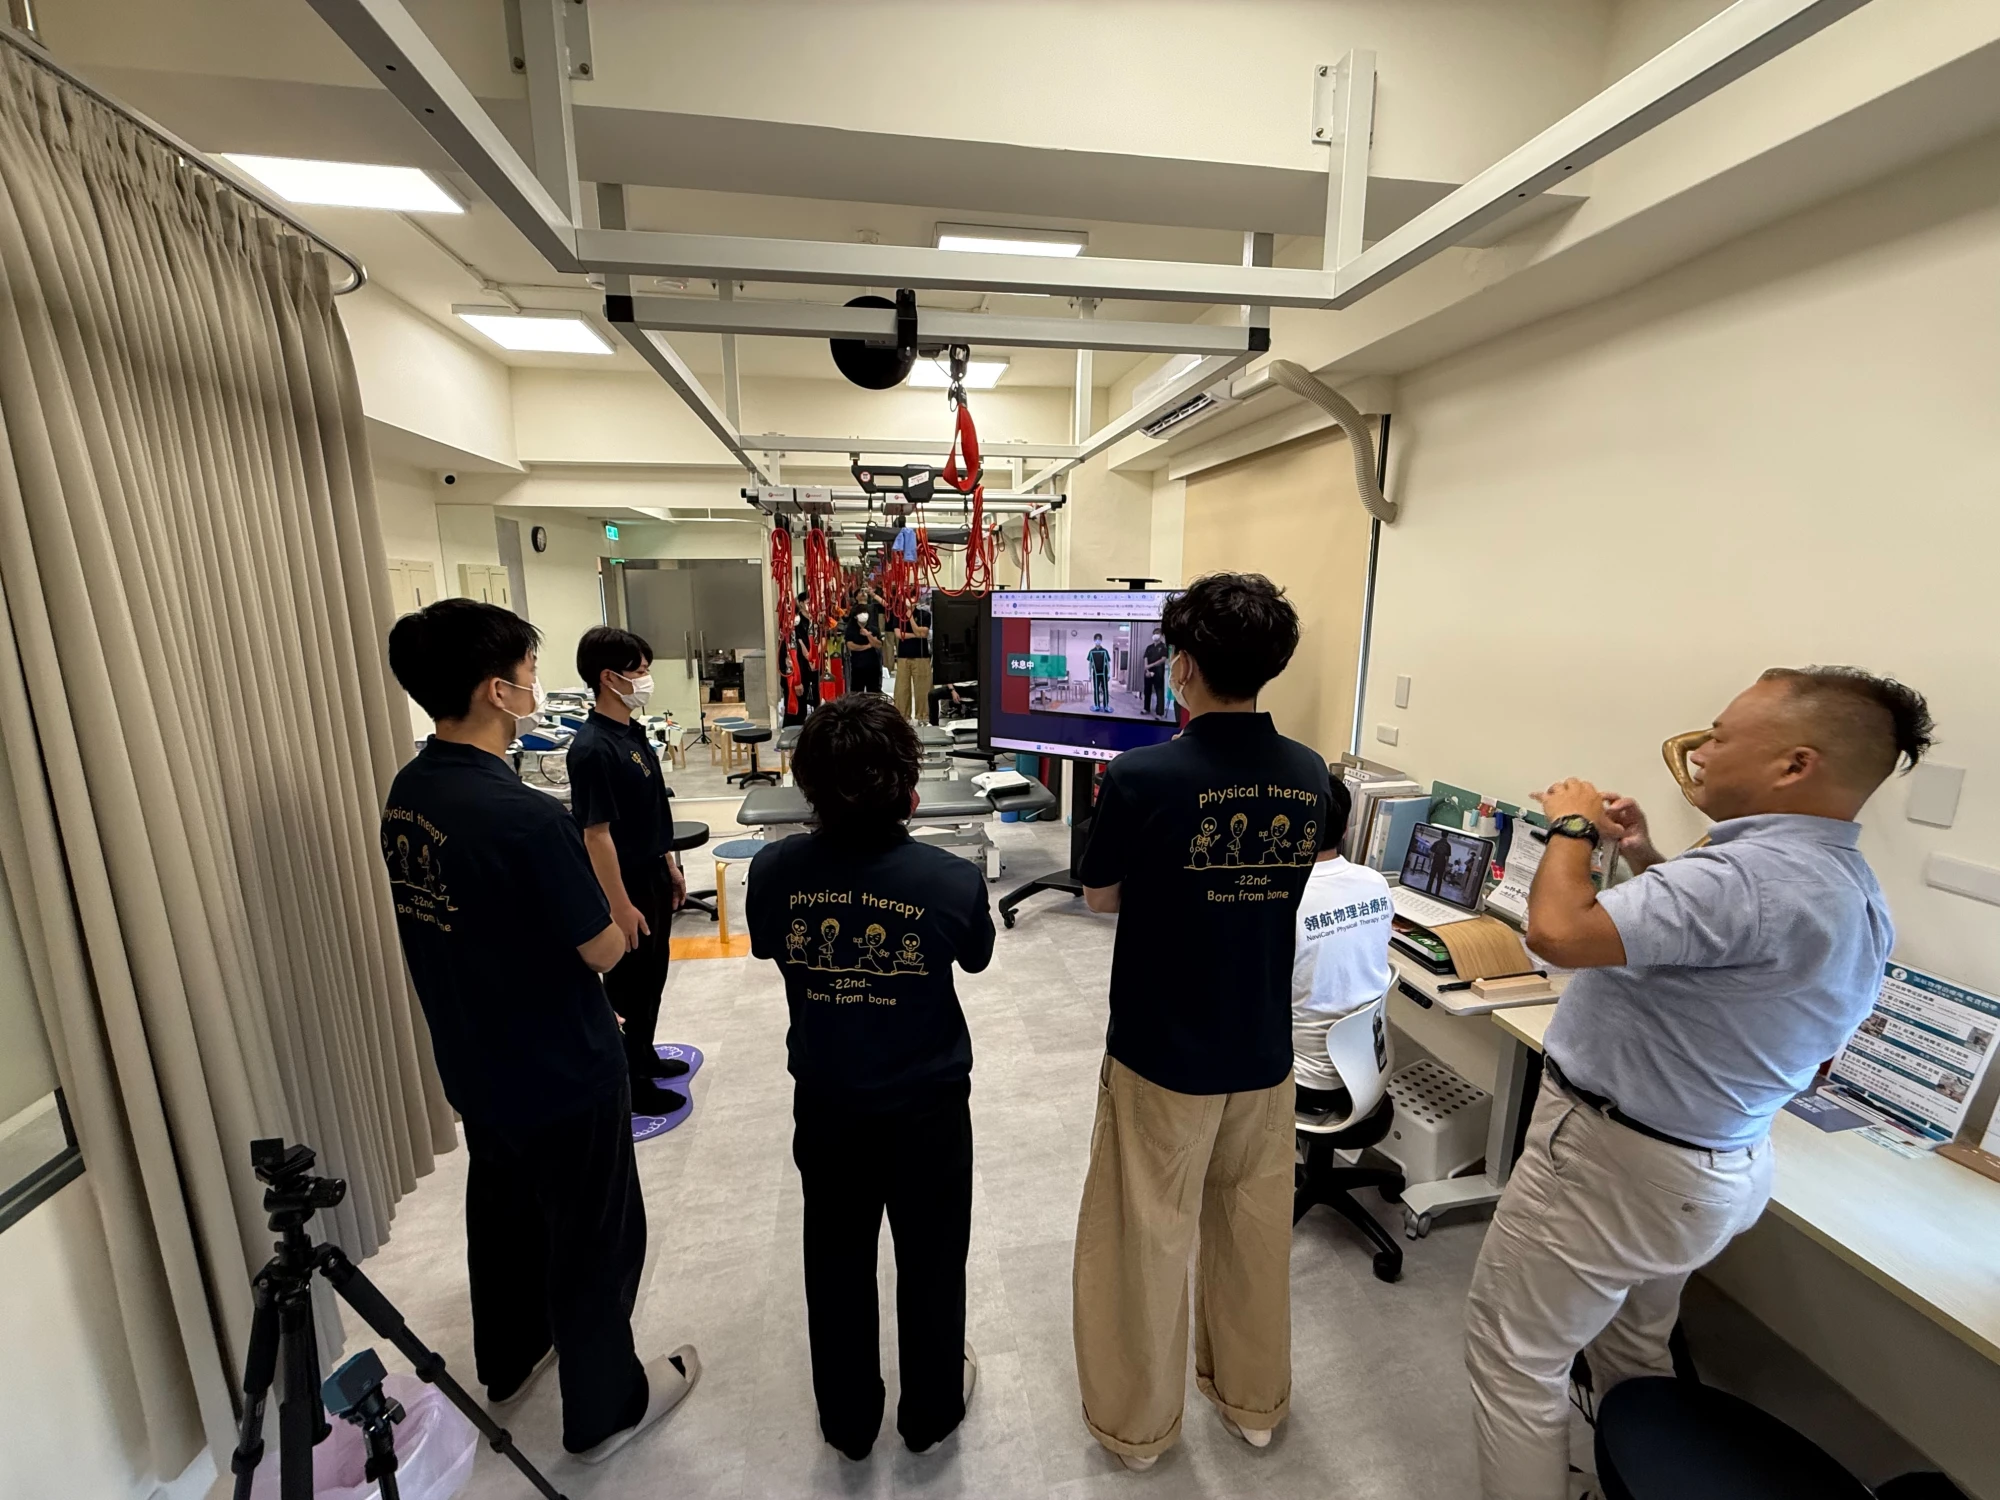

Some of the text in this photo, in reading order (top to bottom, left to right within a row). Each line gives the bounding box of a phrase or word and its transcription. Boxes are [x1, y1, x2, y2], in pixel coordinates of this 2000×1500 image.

[1011, 659, 1035, 670] 休息中
[1199, 784, 1318, 809] physical therapy
[417, 813, 448, 847] therapy
[789, 889, 925, 920] physical therapy
[1207, 889, 1289, 903] Born from bone
[1304, 896, 1389, 932] 領航物理治療所
[1306, 929, 1335, 942] NaviCare
[1336, 922, 1358, 933] Physical
[1359, 917, 1380, 926] Therapy
[806, 988, 897, 1006] Born from bone
